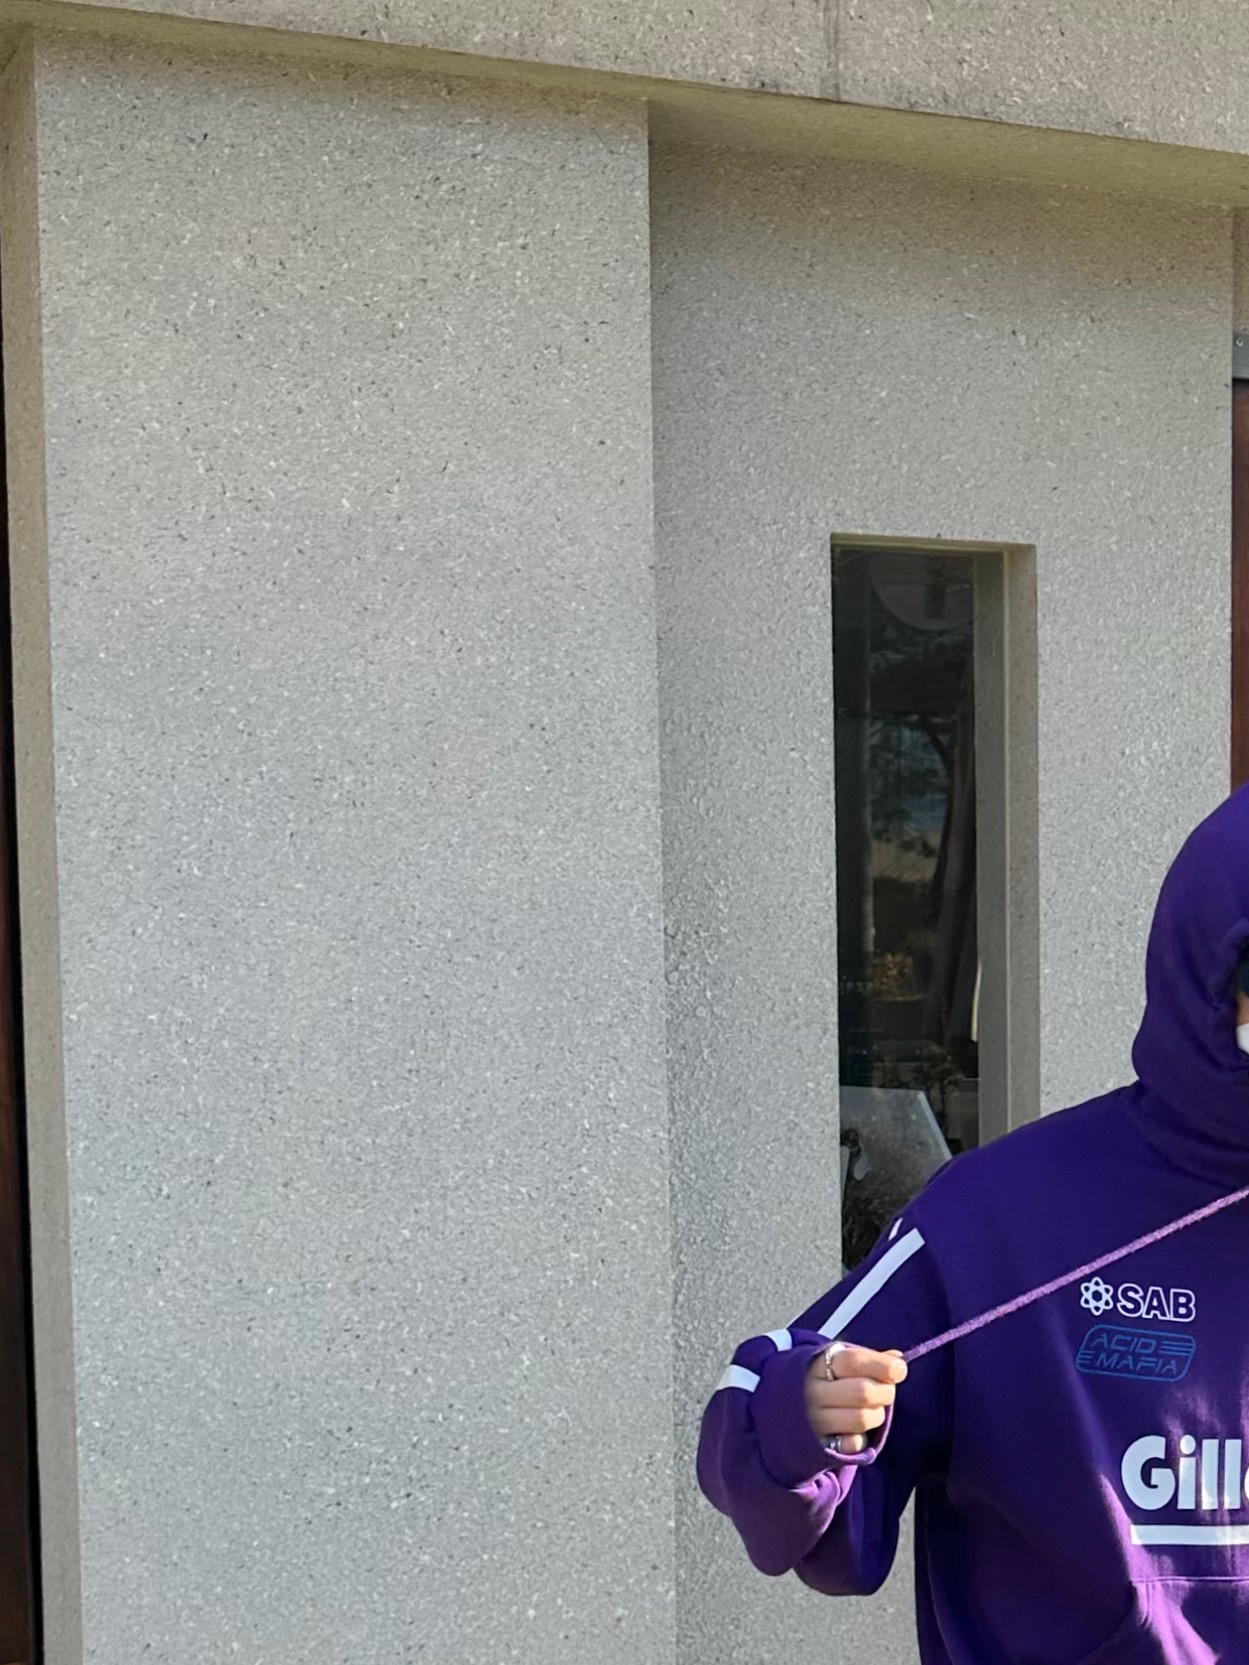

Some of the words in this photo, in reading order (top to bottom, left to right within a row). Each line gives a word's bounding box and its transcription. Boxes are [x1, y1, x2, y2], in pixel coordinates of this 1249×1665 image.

[1117, 1283, 1196, 1322] SAB
[1091, 1332, 1157, 1354] ACID
[1097, 1351, 1177, 1375] MAFIA
